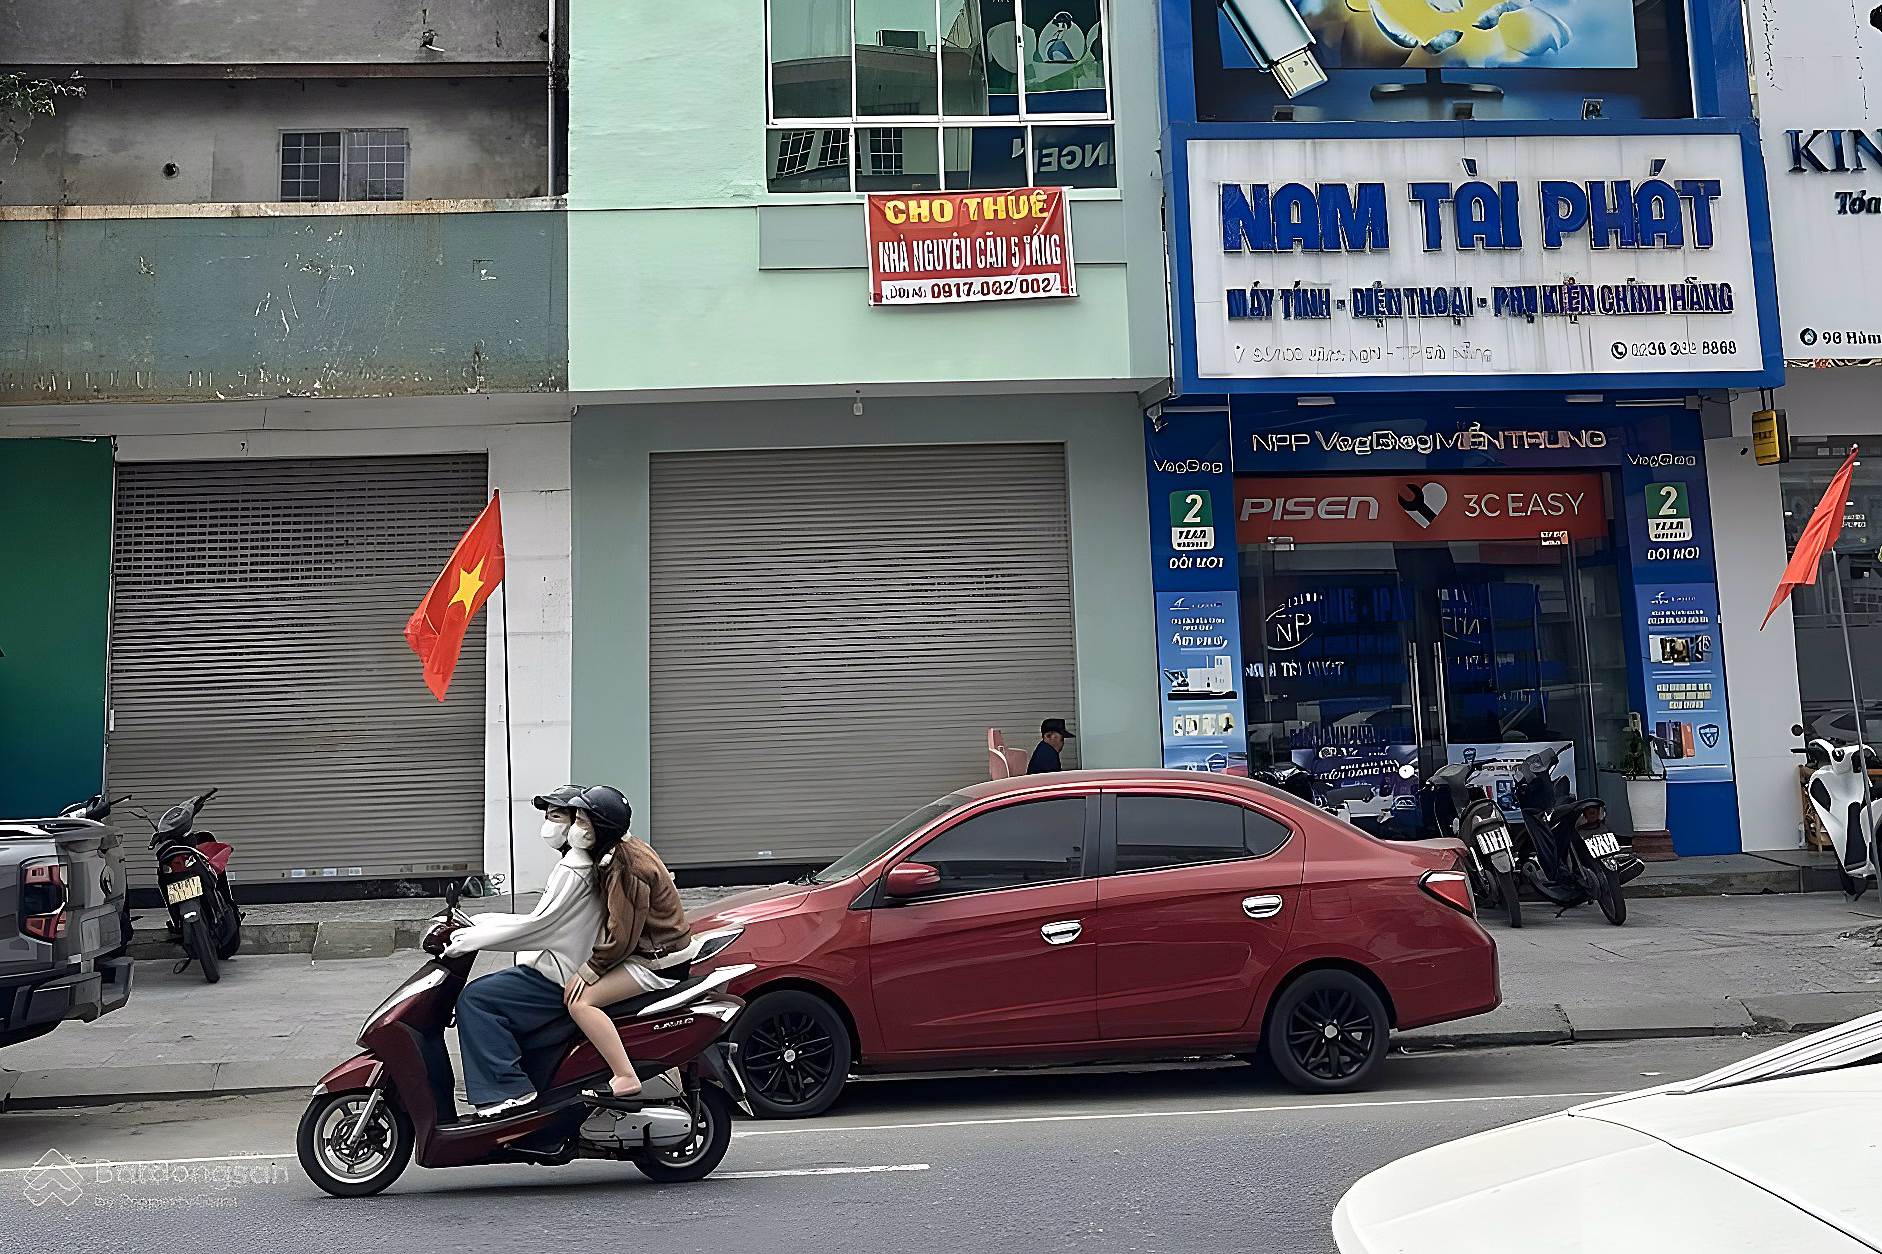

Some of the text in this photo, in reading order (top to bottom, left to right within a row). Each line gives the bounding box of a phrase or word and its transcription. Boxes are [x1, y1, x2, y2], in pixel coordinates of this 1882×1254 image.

[884, 189, 1048, 225] CHO THUÊ
[1219, 157, 1722, 252] NAM TÀI PHÁT
[878, 233, 910, 273] NHÀ
[1011, 236, 1020, 268] 5
[1278, 279, 1332, 320] TÍNH
[1252, 433, 1310, 452] NPP
[1182, 494, 1203, 523] 2
[1239, 492, 1585, 523] PISEN 3C EASY
[1658, 486, 1678, 516] 2
